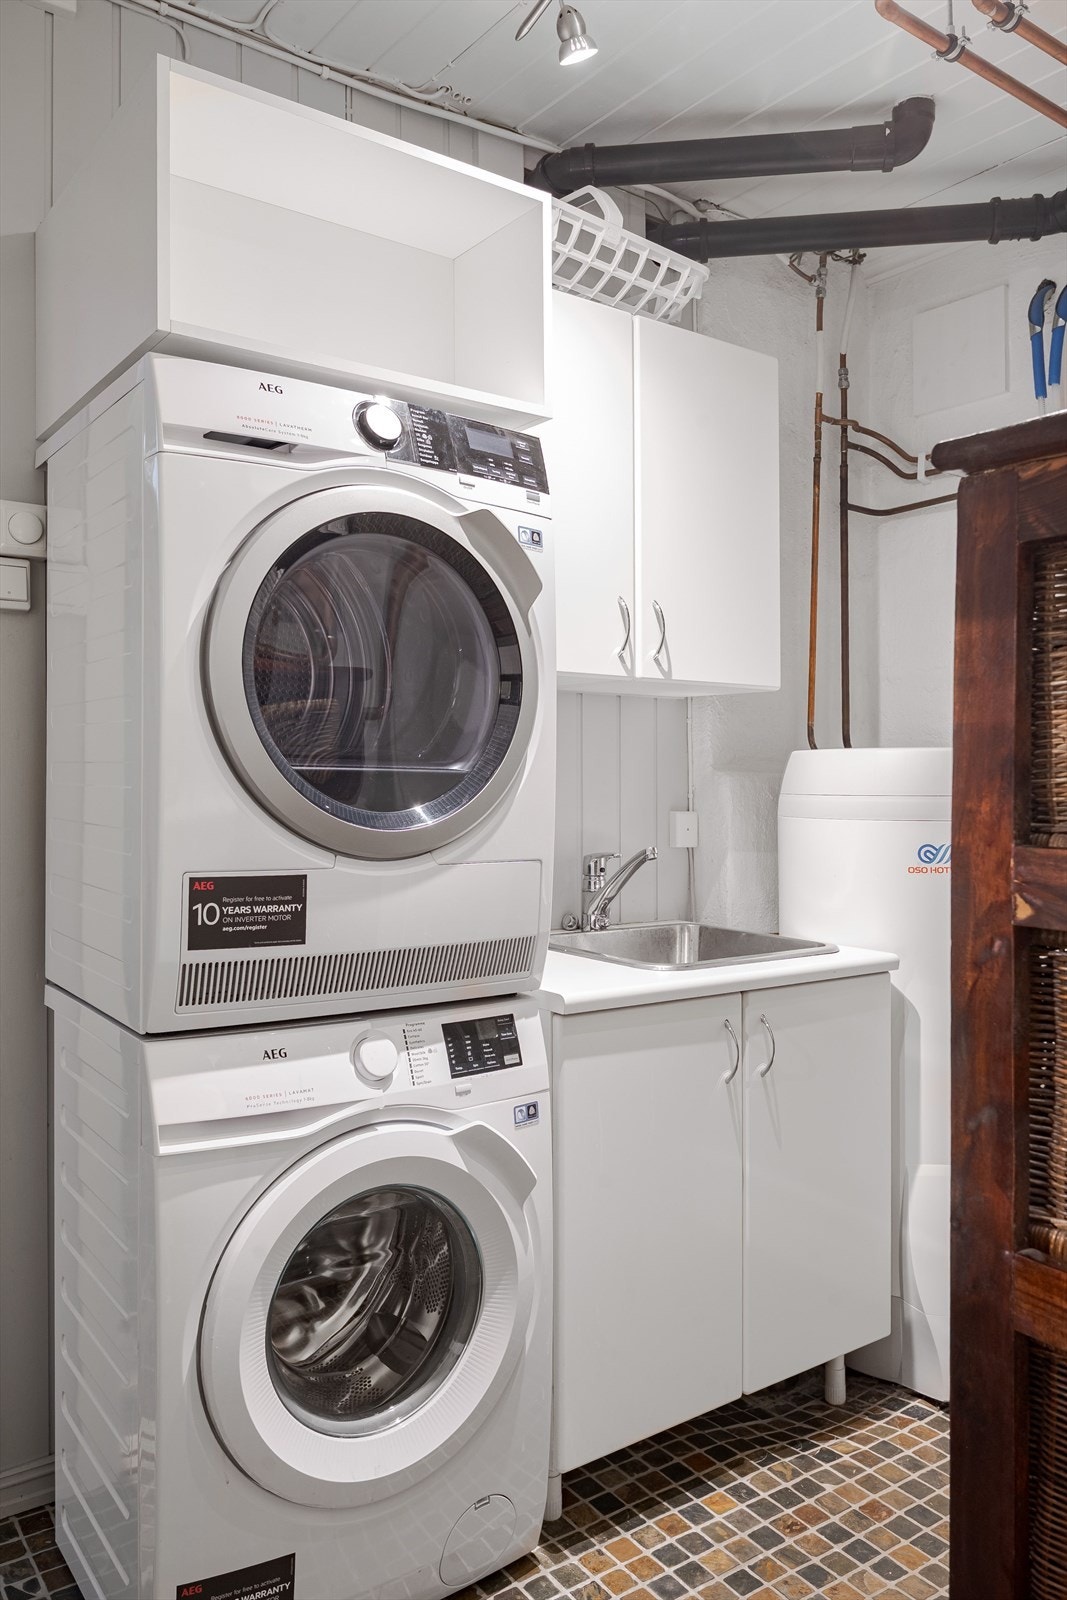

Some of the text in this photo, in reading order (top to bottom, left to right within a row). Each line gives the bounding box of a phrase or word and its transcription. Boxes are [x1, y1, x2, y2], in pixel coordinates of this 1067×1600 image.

[259, 382, 283, 394] AEG
[908, 866, 928, 874] OSO
[193, 881, 214, 890] AEG
[222, 896, 244, 904] Register
[192, 902, 303, 926] 10 YEARS WARRANTY
[222, 916, 234, 924] ON
[234, 915, 267, 923] INVERTER
[222, 924, 268, 932] aeg.com/register
[263, 1048, 287, 1060] AEG
[262, 1091, 282, 1099] SERIES
[288, 1087, 315, 1096] LAVAMAT
[181, 1585, 202, 1596] AEG
